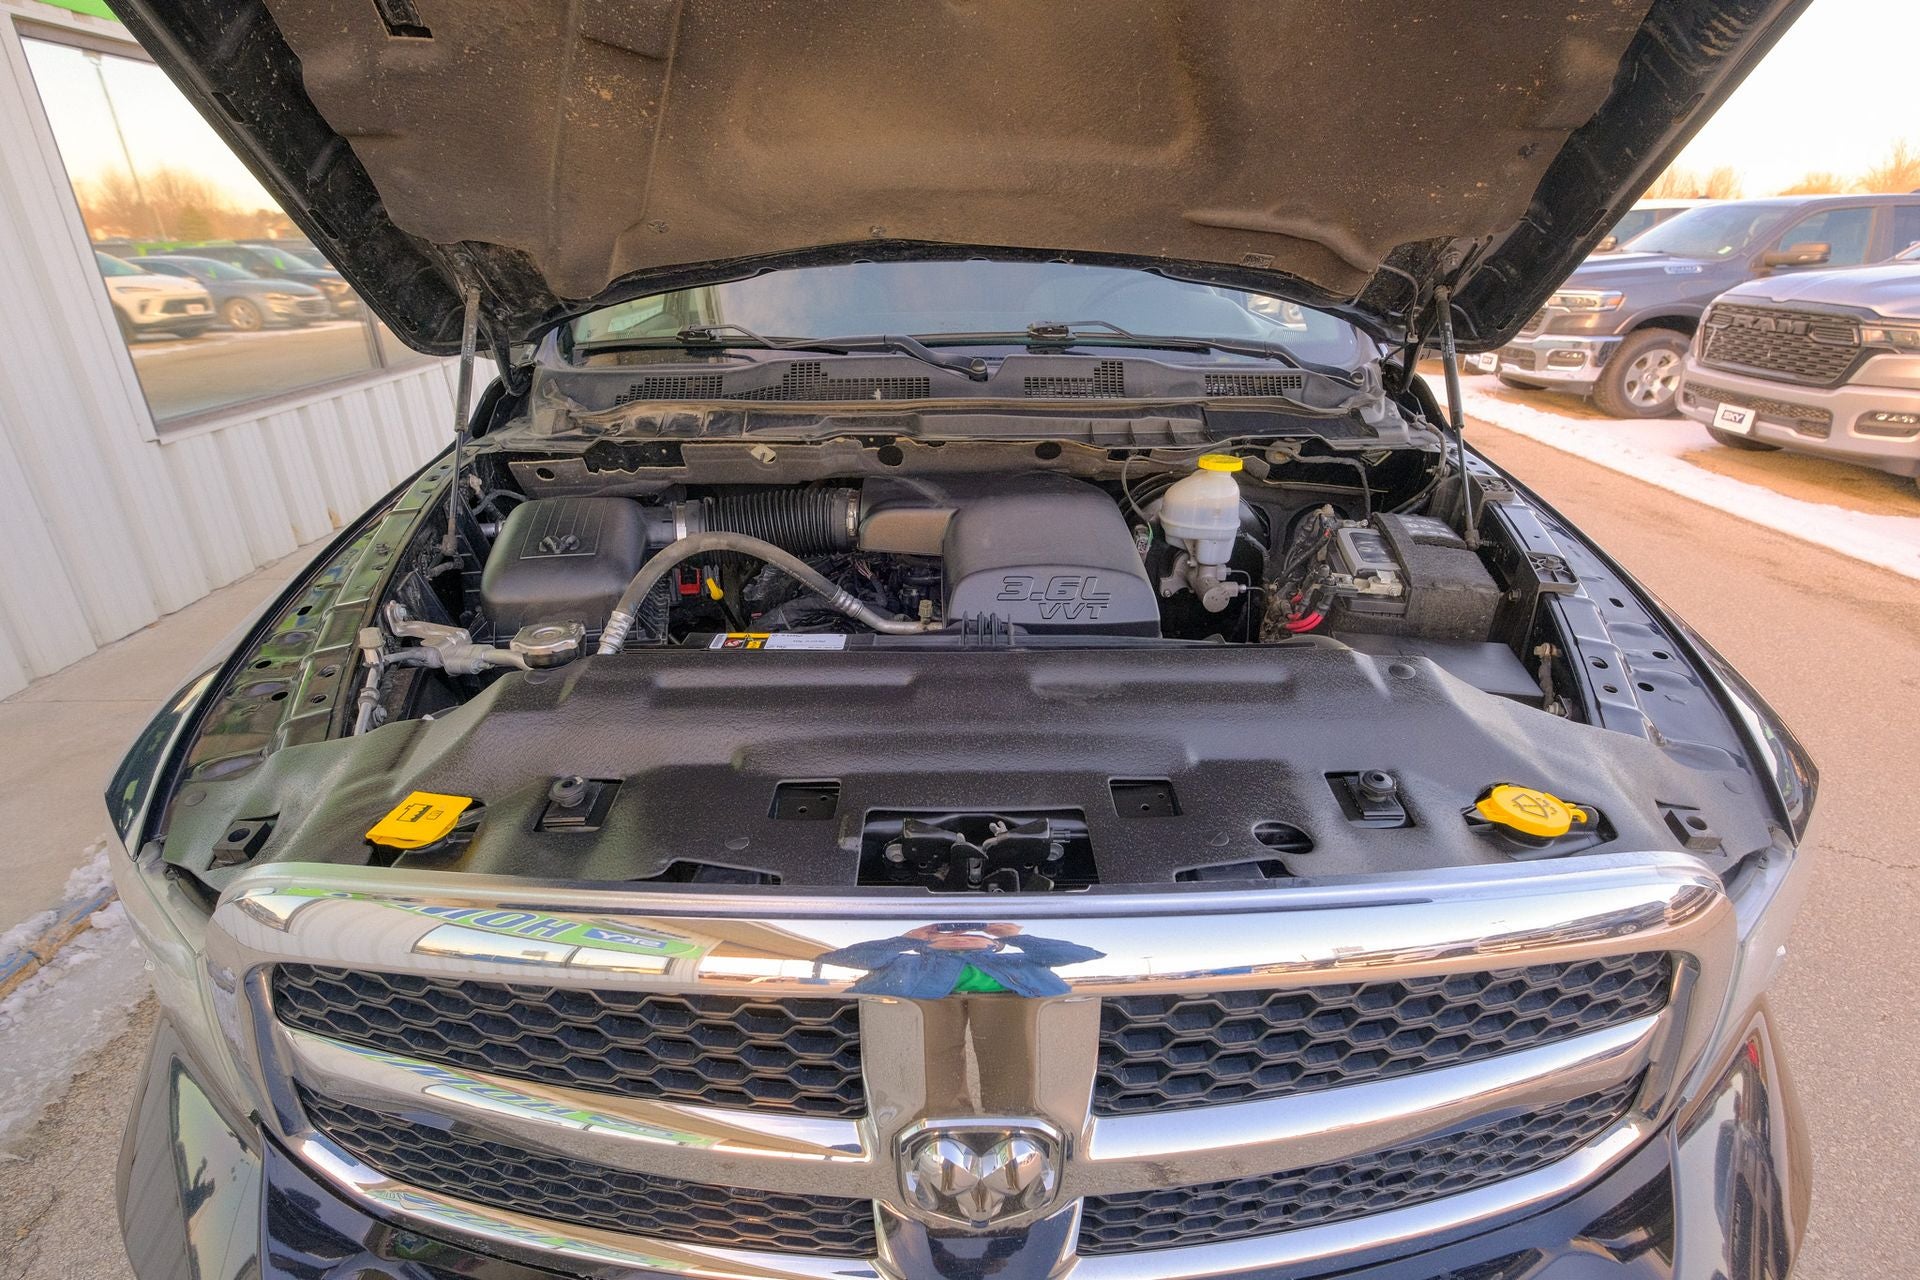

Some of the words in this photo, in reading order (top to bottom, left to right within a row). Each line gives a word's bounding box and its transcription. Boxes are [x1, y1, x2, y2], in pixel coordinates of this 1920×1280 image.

[1732, 314, 1811, 337] RAM
[997, 575, 1112, 601] 3.6L
[1038, 602, 1109, 620] VVT
